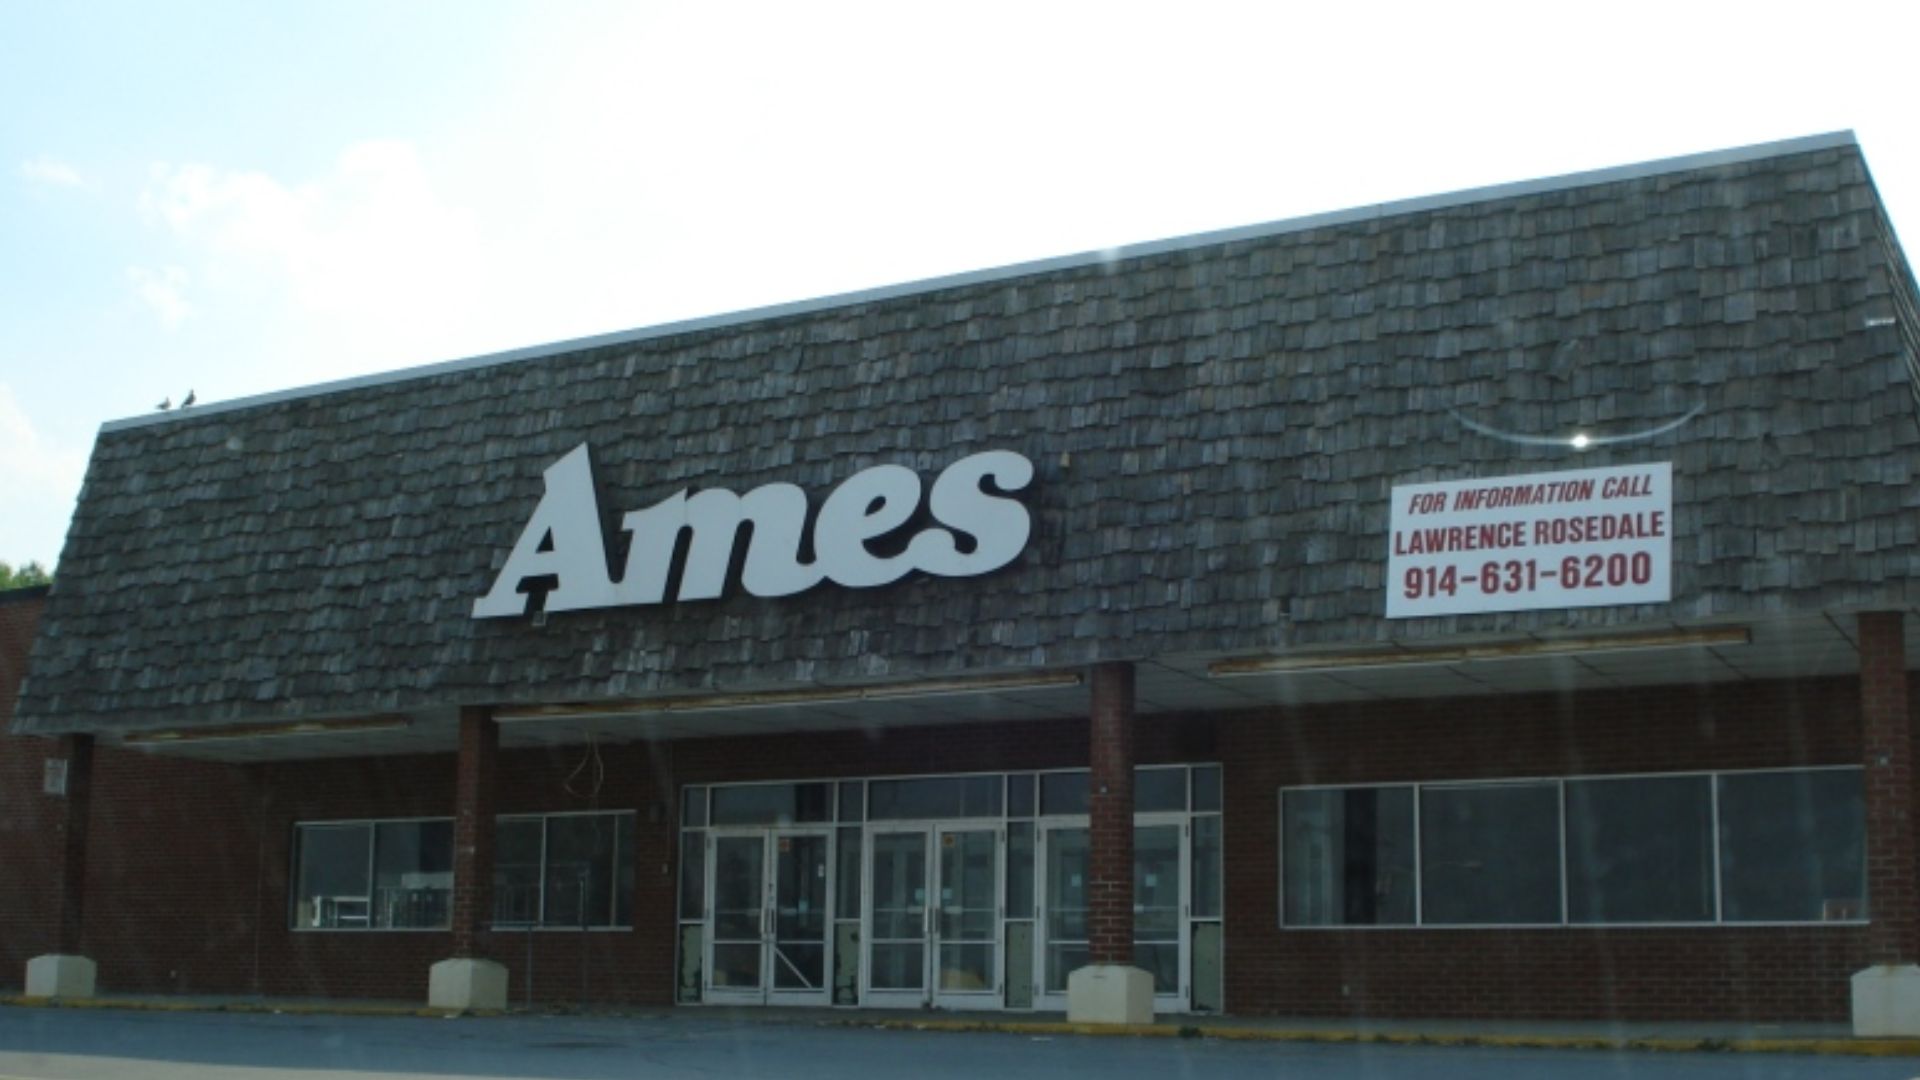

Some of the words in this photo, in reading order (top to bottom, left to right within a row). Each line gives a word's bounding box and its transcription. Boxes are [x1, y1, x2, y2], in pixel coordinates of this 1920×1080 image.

[1408, 491, 1447, 515] FOR
[1453, 478, 1596, 512] INFORMATION
[1601, 474, 1653, 500] CALL
[471, 441, 1034, 619] Ames
[1394, 520, 1527, 556] LAWRENCE
[1533, 510, 1665, 546] ROSEDALE
[1403, 551, 1653, 600] 914-631-6200
